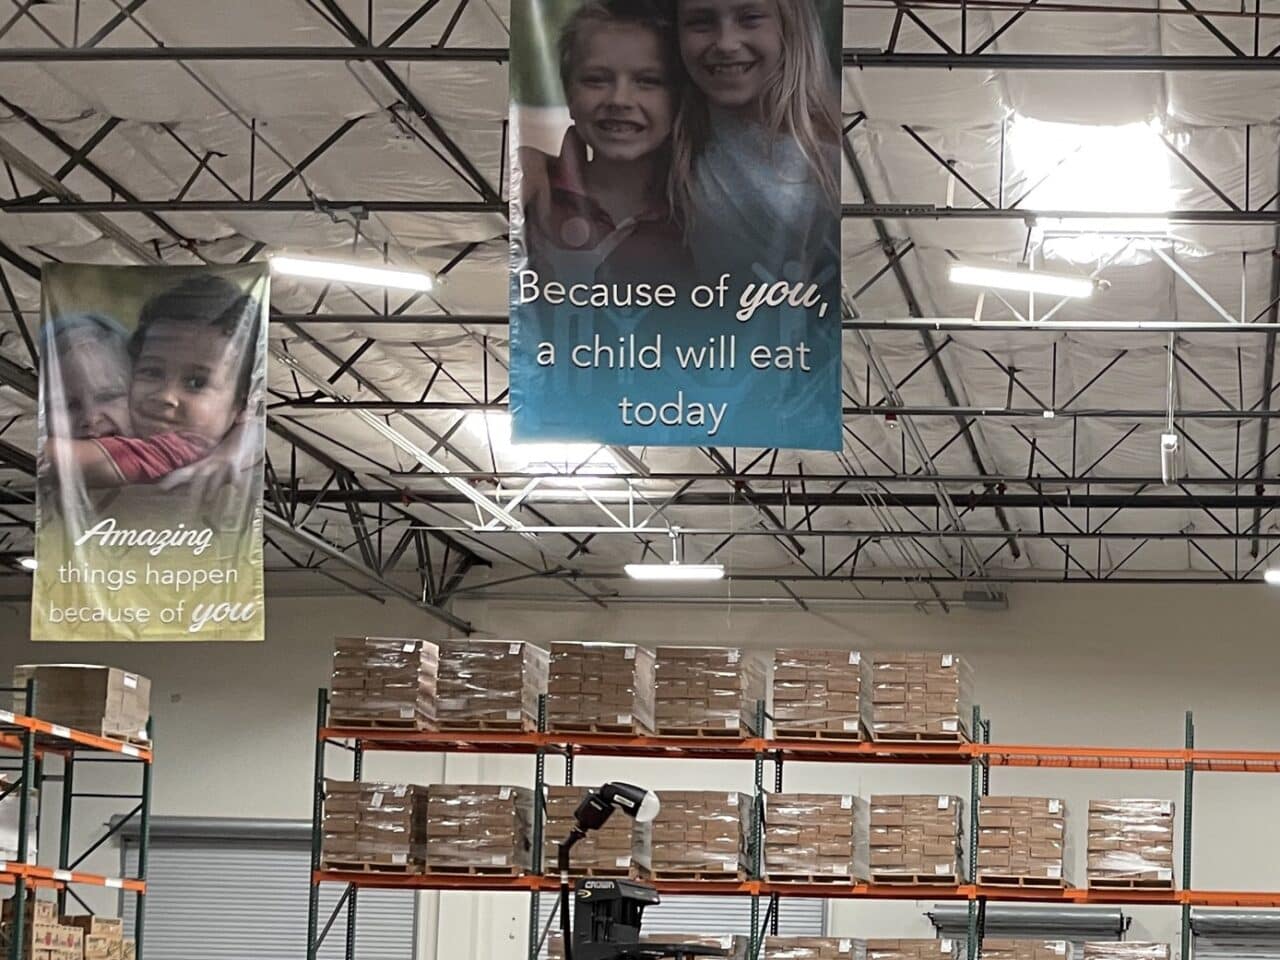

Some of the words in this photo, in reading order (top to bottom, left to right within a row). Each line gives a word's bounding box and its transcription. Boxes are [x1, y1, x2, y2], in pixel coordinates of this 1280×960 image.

[519, 270, 677, 308] Because
[690, 273, 731, 308] of
[735, 280, 829, 322] you,
[536, 341, 555, 367] a
[571, 334, 662, 369] child
[675, 334, 736, 369] will
[750, 340, 811, 371] eat
[618, 391, 728, 435] today
[74, 518, 214, 555] Amazing
[58, 560, 137, 591] things
[146, 562, 238, 592] happen
[49, 601, 150, 623] because
[160, 600, 184, 623] of
[189, 601, 256, 633] you
